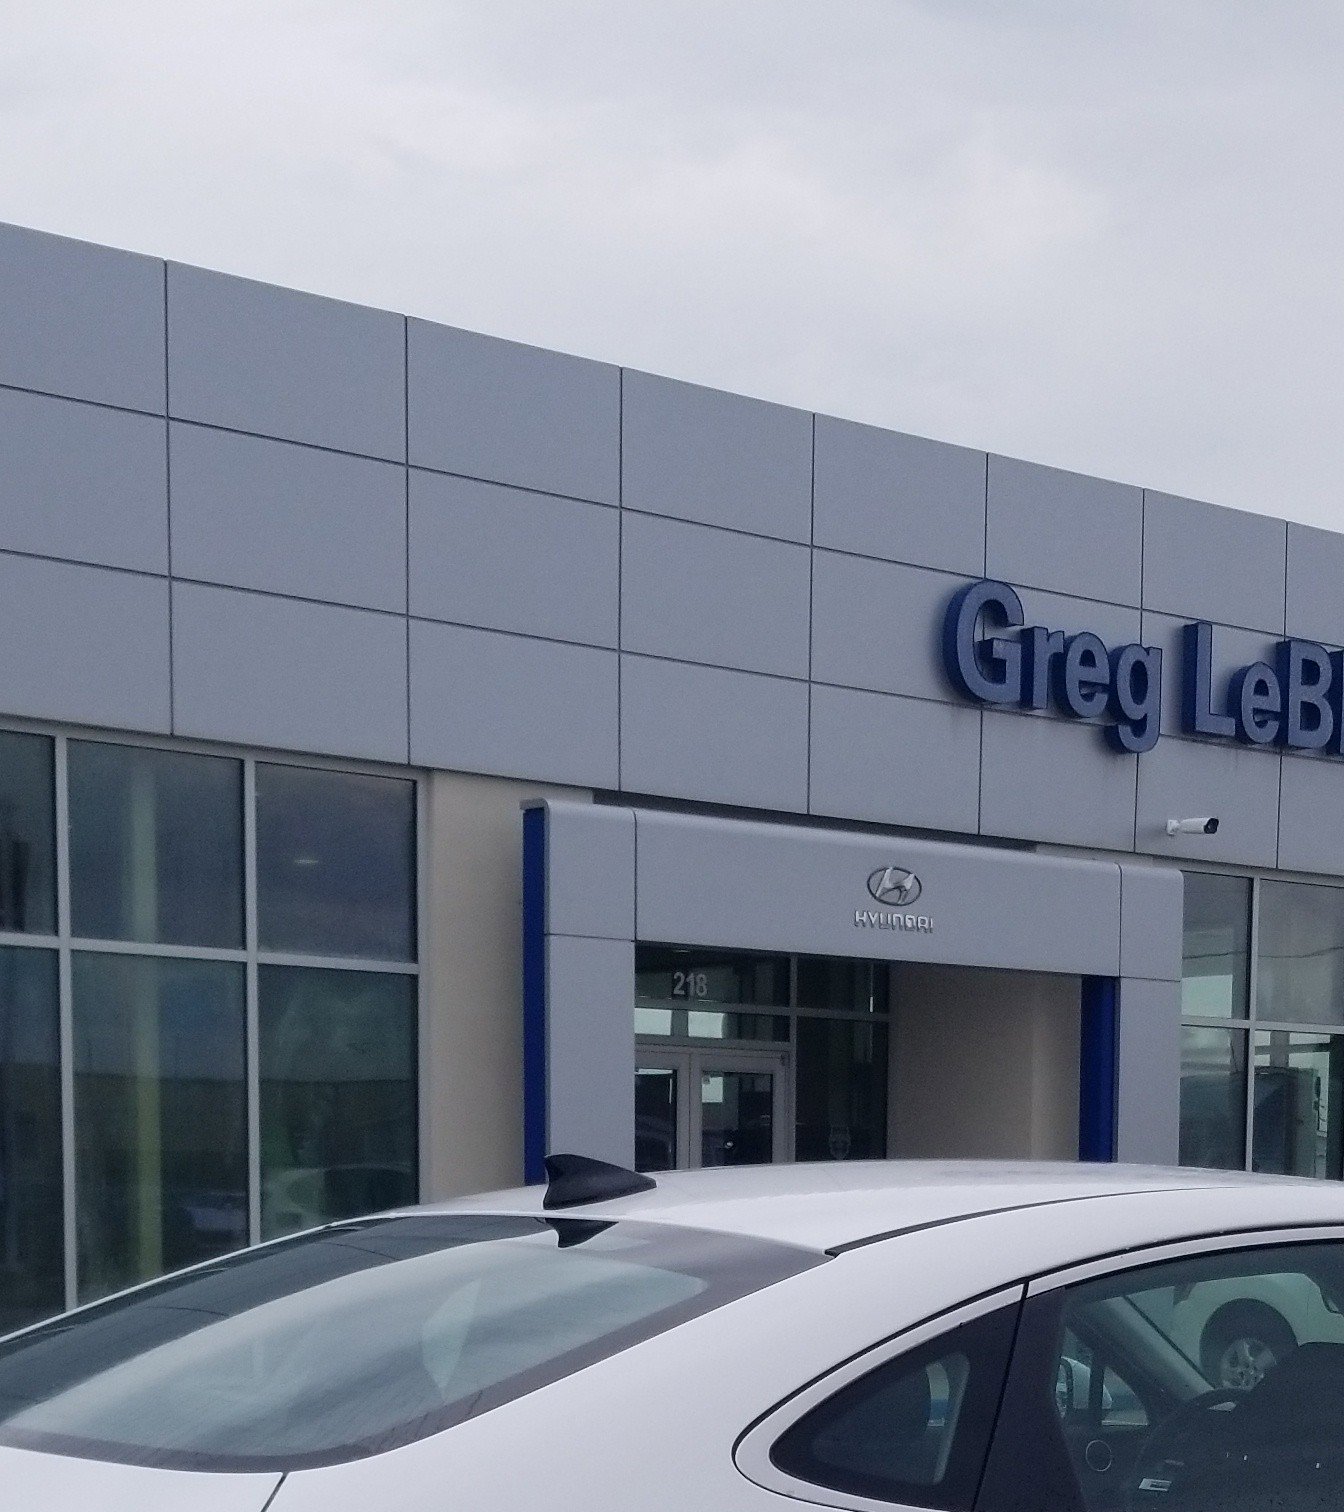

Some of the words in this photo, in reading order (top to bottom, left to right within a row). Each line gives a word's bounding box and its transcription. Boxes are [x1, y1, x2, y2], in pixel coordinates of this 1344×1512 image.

[941, 579, 1163, 753] Greg
[854, 910, 934, 934] HYUNDAI
[673, 971, 708, 997] 218
